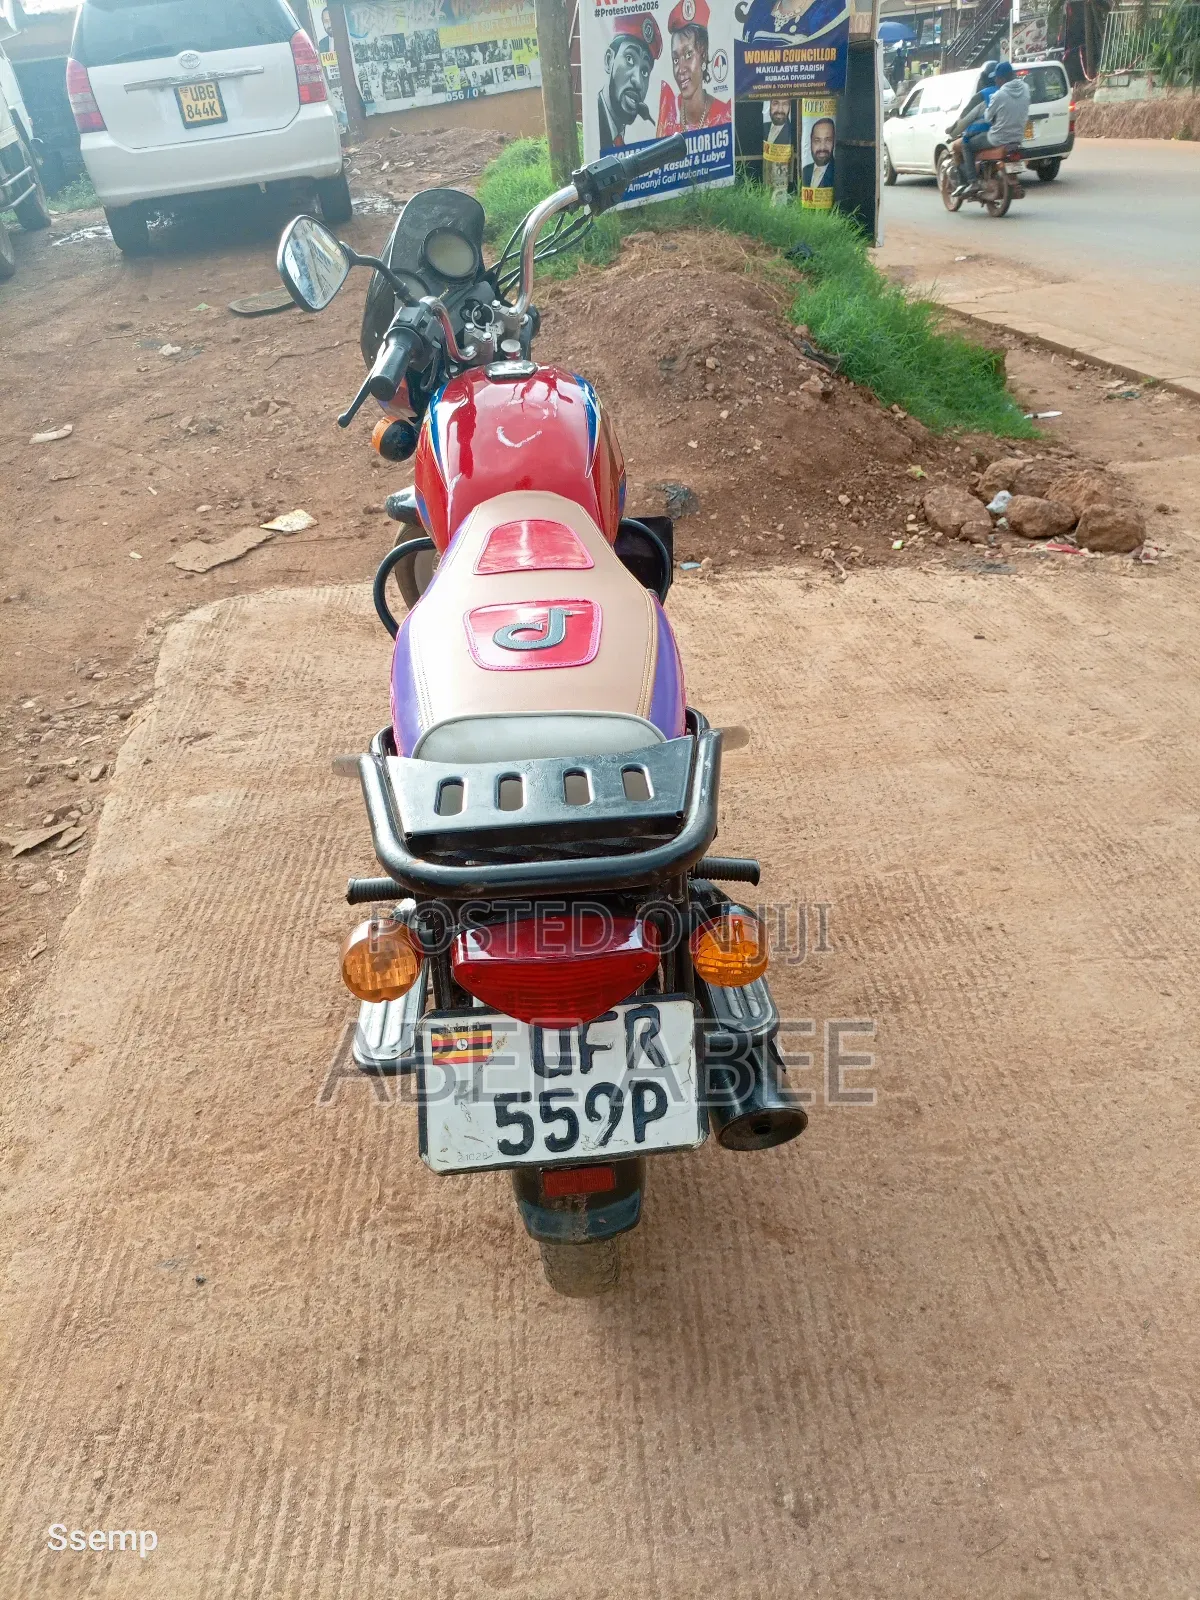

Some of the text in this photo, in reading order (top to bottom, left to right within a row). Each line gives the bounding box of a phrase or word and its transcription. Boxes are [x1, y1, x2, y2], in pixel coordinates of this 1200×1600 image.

[594, 1, 659, 17] #Protestvote2026
[744, 48, 837, 64] WOMAN COUNCILLOR
[756, 64, 825, 74] NAKULABYE PARISH
[189, 84, 216, 101] UBG
[446, 91, 464, 102] 056
[186, 100, 218, 119] 844K
[711, 129, 729, 150] LC5
[664, 154, 693, 172] Kasubi
[694, 154, 700, 166] &
[701, 150, 727, 165] Lubya
[627, 175, 661, 193] Amaanyi
[529, 1004, 667, 1079] UFR
[493, 1079, 668, 1156] 559P
